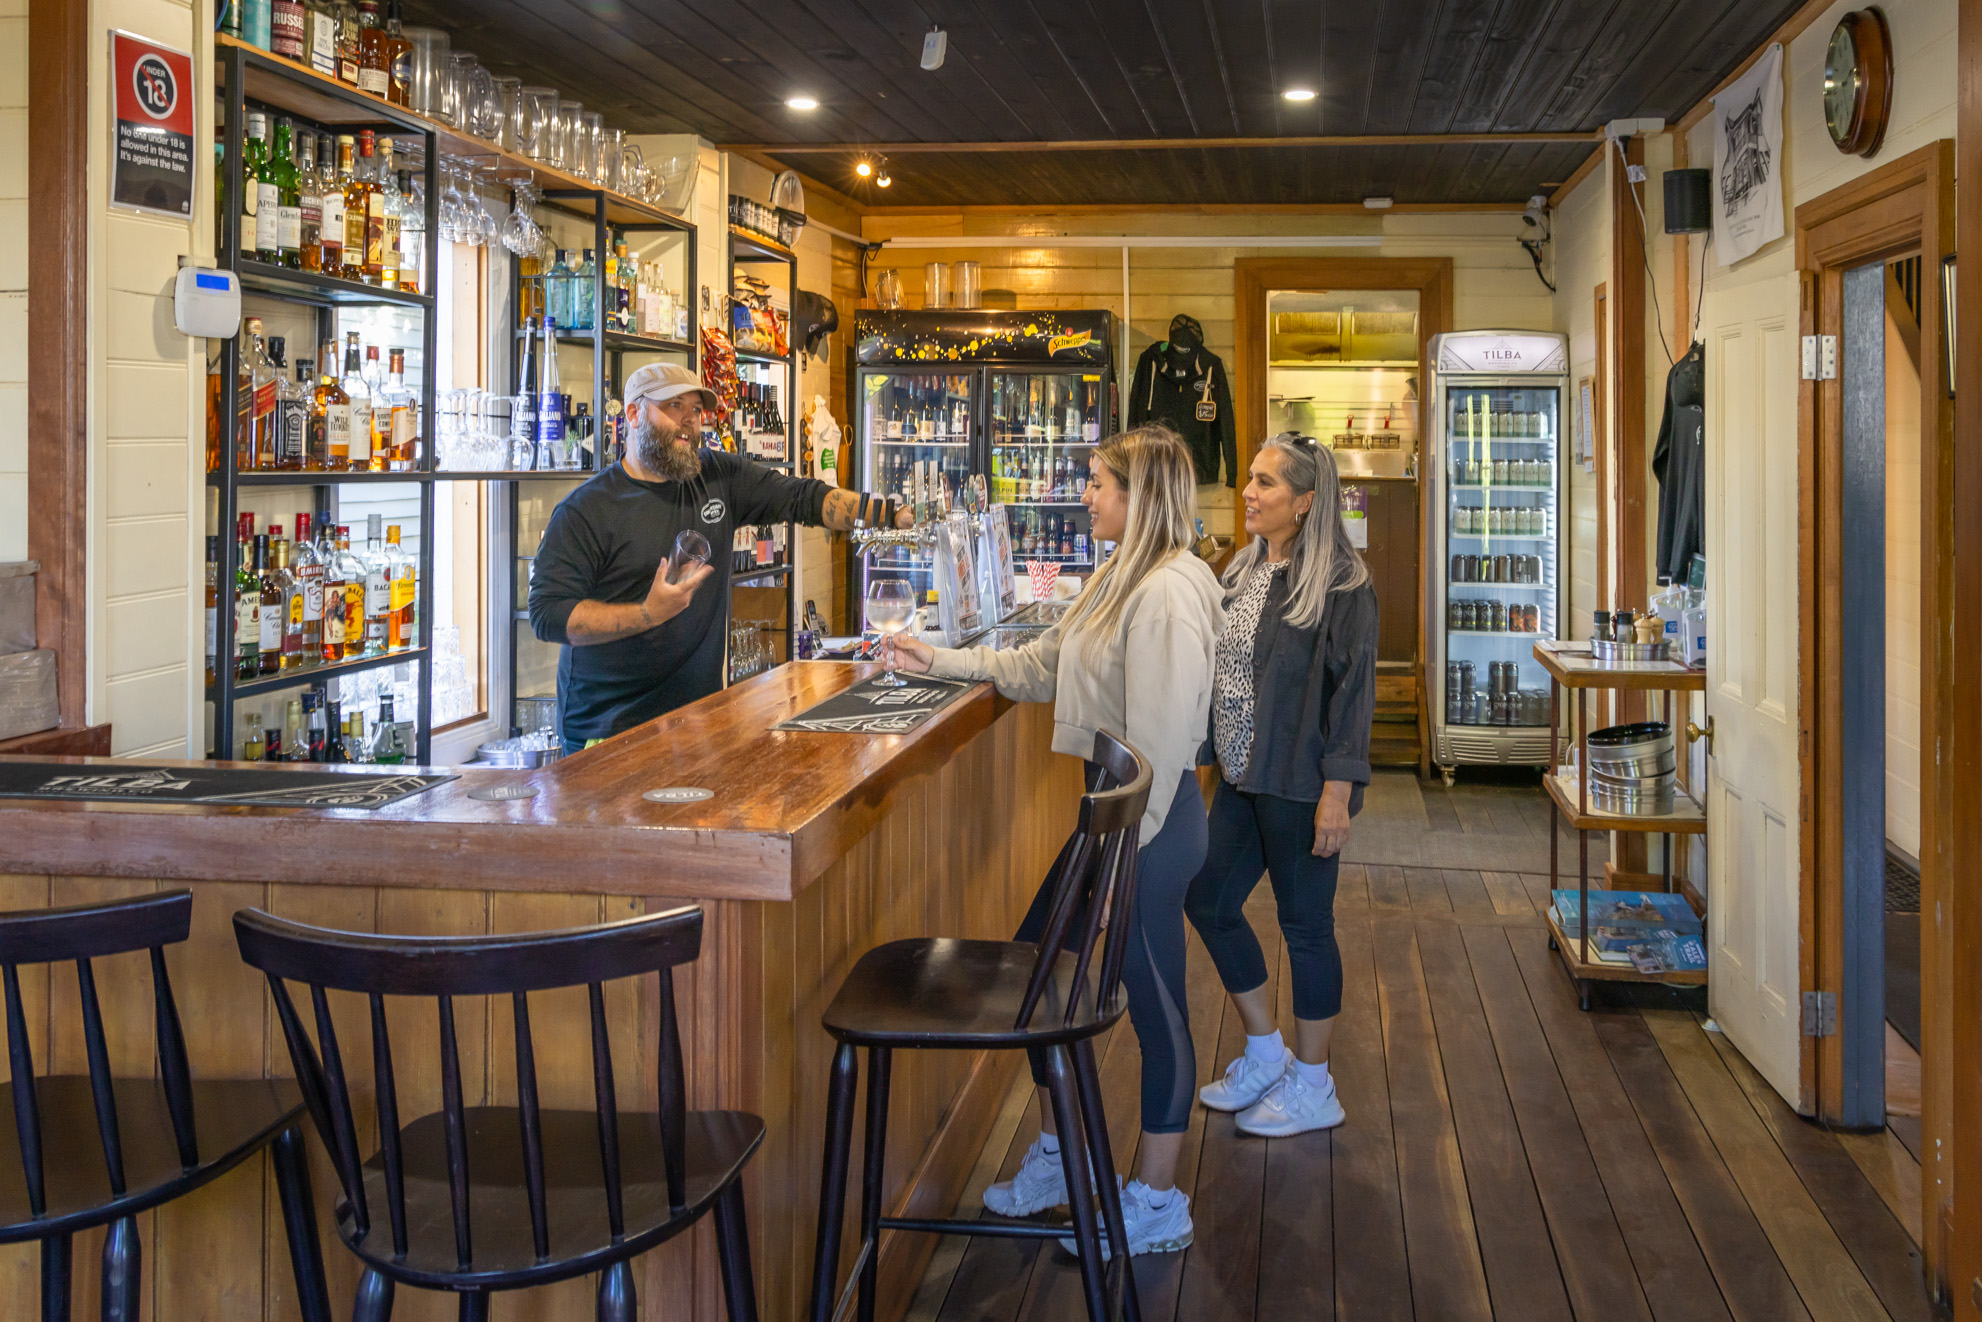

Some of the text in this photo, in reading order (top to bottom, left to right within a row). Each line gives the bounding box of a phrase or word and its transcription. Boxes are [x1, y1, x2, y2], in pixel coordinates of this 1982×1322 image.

[143, 65, 166, 78] UNDER
[143, 79, 168, 107] 18
[120, 125, 186, 149] No one under 18 is
[120, 139, 189, 162] allowed in this area.
[120, 150, 186, 173] It's against the law.
[1053, 336, 1086, 349] Schweppes
[1482, 350, 1522, 360] TILBA
[45, 776, 192, 790] TILBA
